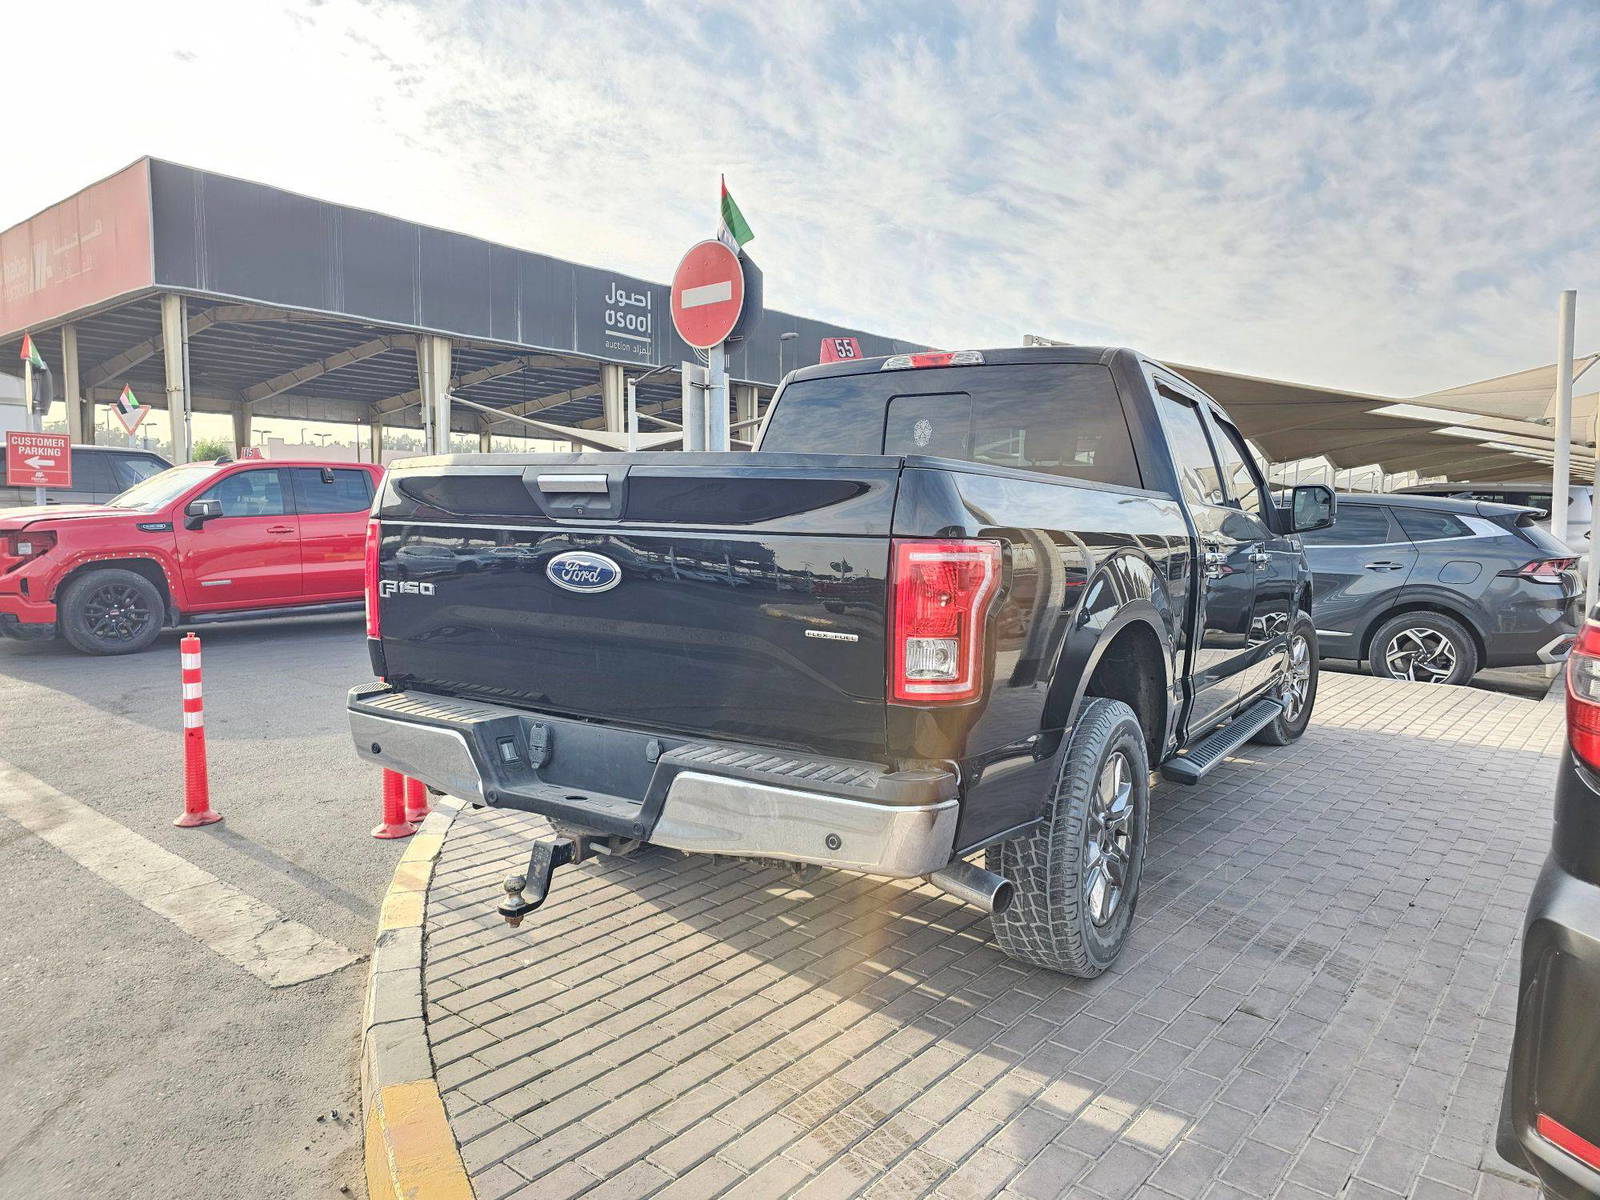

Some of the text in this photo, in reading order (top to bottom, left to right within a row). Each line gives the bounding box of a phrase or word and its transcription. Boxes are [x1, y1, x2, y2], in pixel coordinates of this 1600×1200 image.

[605, 340, 631, 352] auction
[834, 339, 855, 358] 55
[11, 436, 65, 447] CUSTOMER
[18, 446, 61, 457] PARKING
[561, 559, 601, 582] Ford
